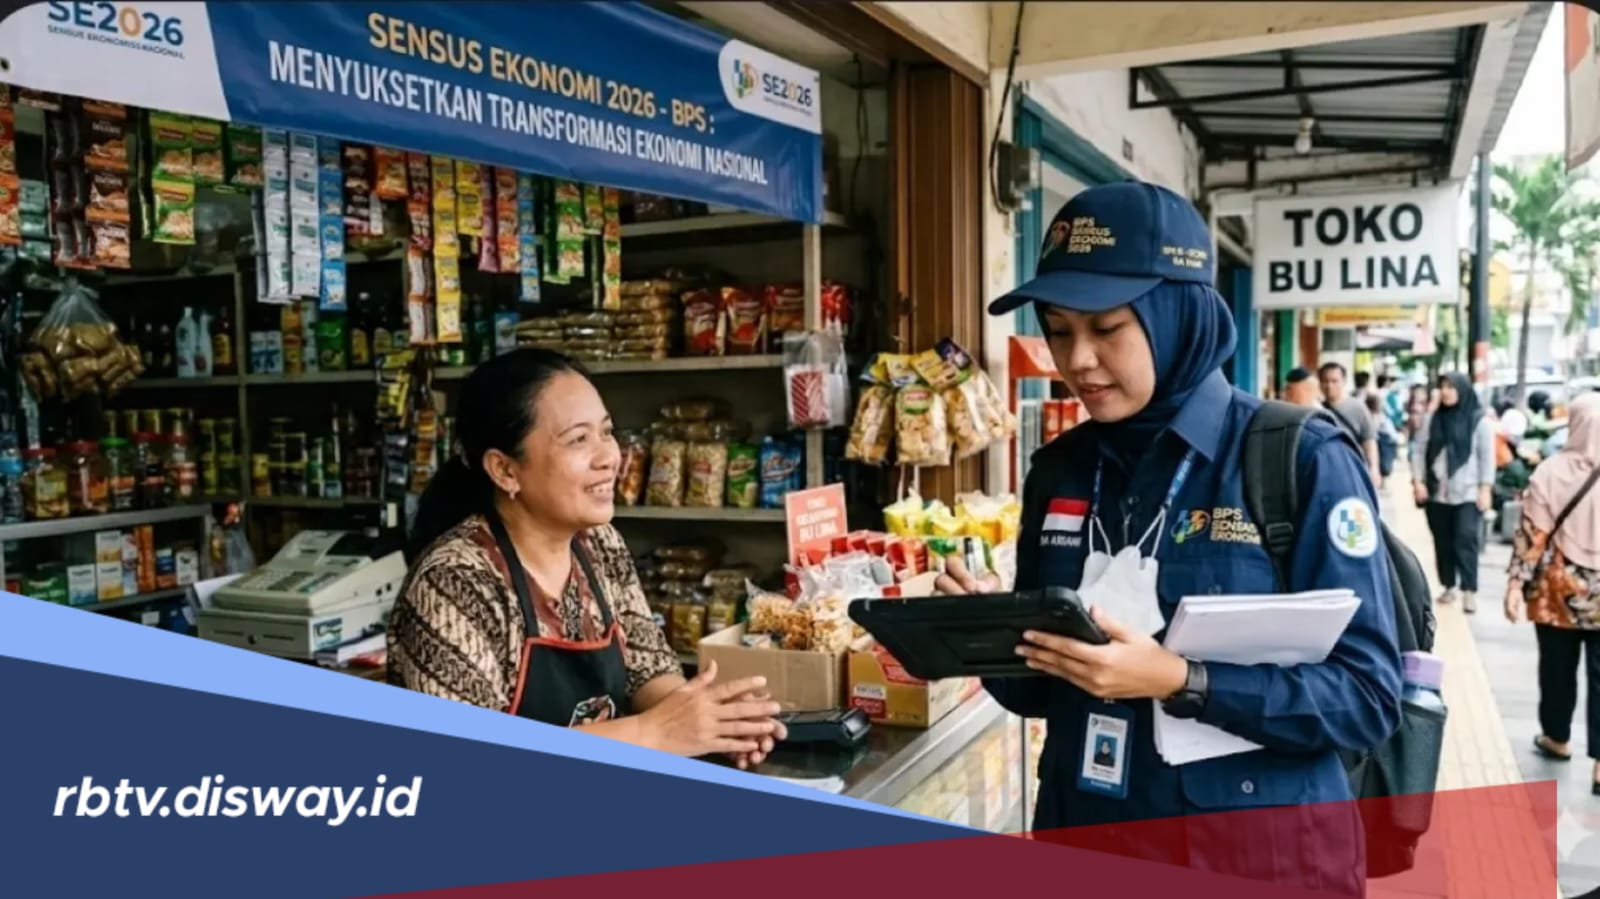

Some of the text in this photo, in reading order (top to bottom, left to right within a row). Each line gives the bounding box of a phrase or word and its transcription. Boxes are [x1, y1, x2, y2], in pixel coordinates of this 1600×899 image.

[48, 1, 184, 46] SE2026
[368, 12, 483, 74] SENSUS
[490, 46, 602, 105] EKONOMI
[606, 80, 656, 118] 2026
[671, 99, 707, 132] BPS
[762, 73, 812, 107] SE2026
[268, 39, 768, 185] MENYUKSETKAN TRANSFORMASI EKONOMI NASIONAL
[1283, 203, 1423, 247] TOKO
[1269, 254, 1440, 293] BU LINA
[1213, 507, 1243, 520] BPS
